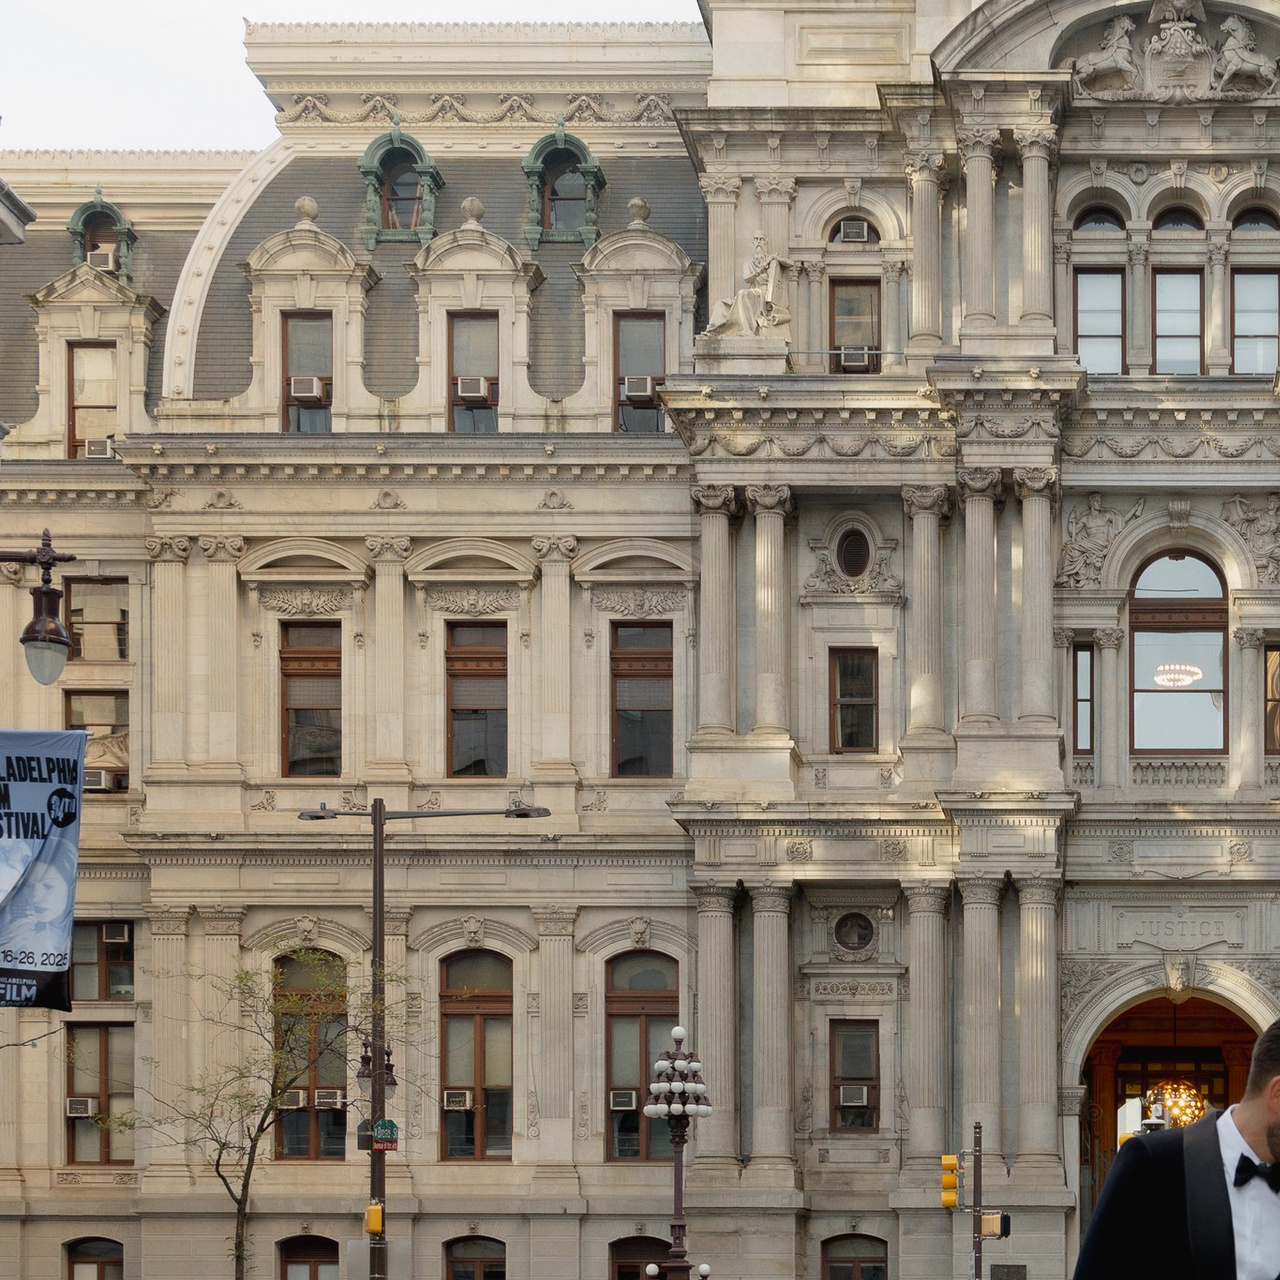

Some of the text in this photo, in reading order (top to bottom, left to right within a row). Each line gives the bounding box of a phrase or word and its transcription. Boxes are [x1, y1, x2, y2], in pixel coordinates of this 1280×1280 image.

[1135, 920, 1225, 937] JUSTICE
[1, 949, 68, 967] 16-26, 2025
